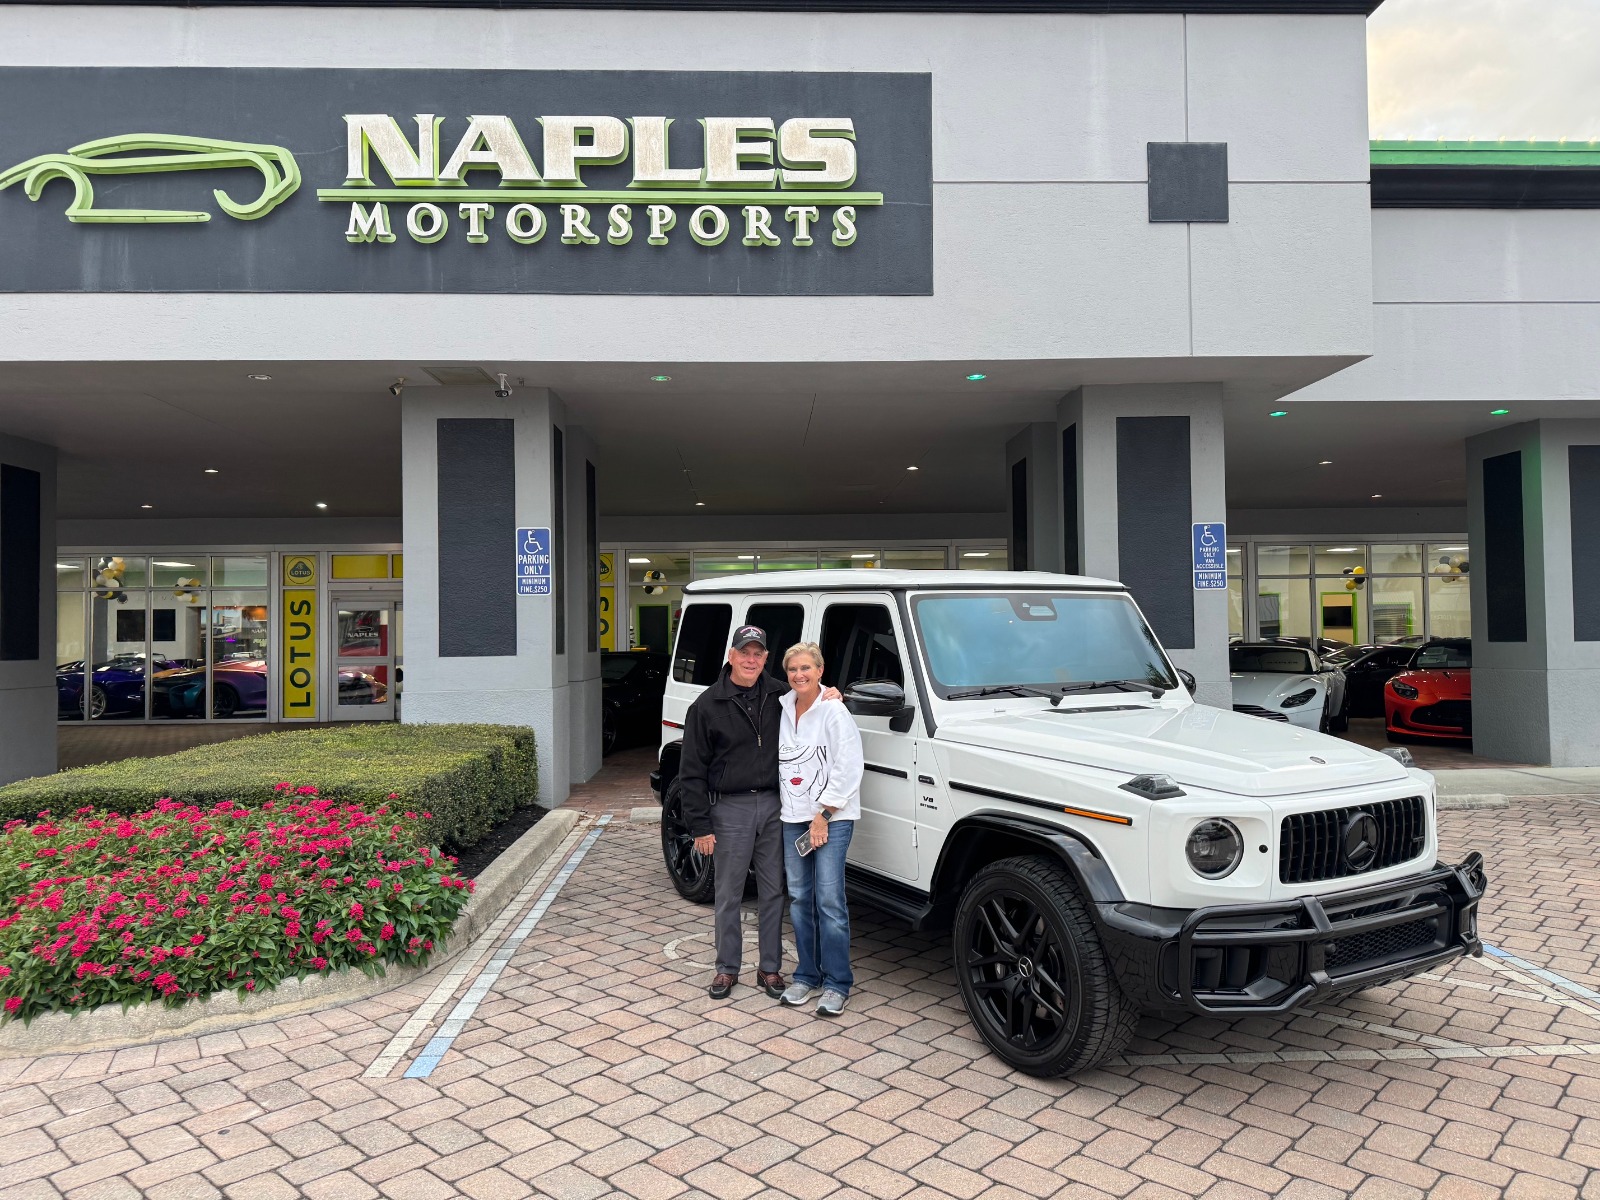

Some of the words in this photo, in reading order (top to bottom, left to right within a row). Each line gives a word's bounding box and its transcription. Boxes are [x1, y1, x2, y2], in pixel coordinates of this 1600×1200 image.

[342, 113, 857, 189] NAPLES
[345, 202, 857, 247] MOTORSPORTS
[518, 554, 549, 564] PARKING
[524, 565, 543, 575] ONLY
[520, 585, 533, 593] FINE
[290, 600, 312, 707] LOTUS
